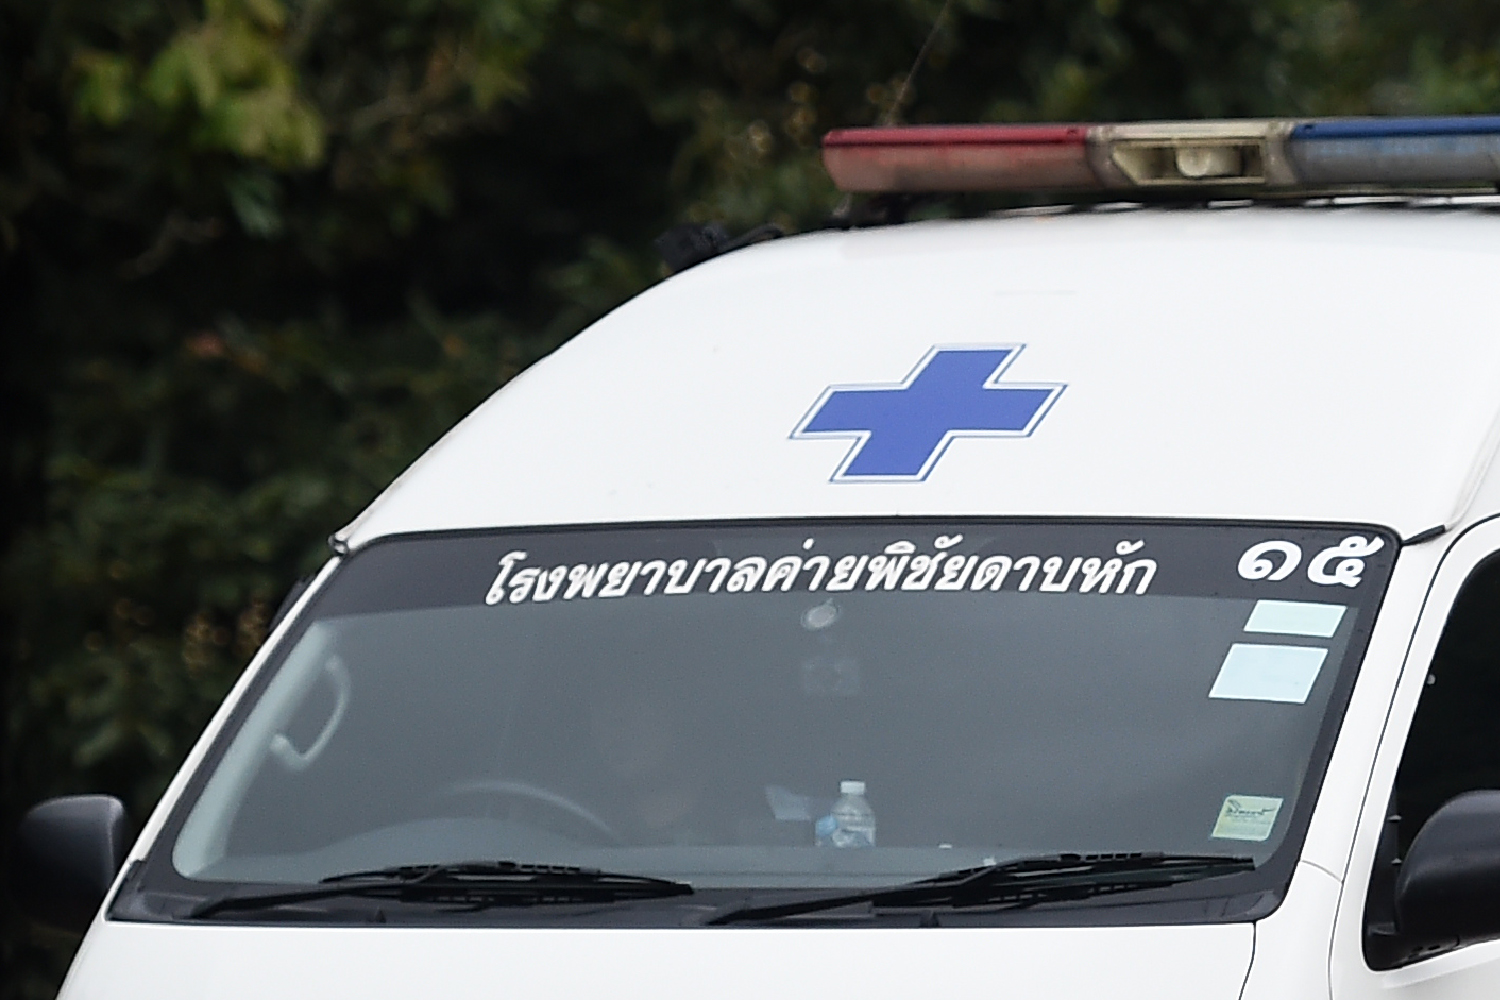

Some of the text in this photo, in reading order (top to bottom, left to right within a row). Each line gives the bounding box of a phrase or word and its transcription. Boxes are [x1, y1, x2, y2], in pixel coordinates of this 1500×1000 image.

[485, 534, 1158, 606] โรงพยาบาลค่ายพิชัยดาบหัก
[1237, 535, 1385, 588] ๑๕
